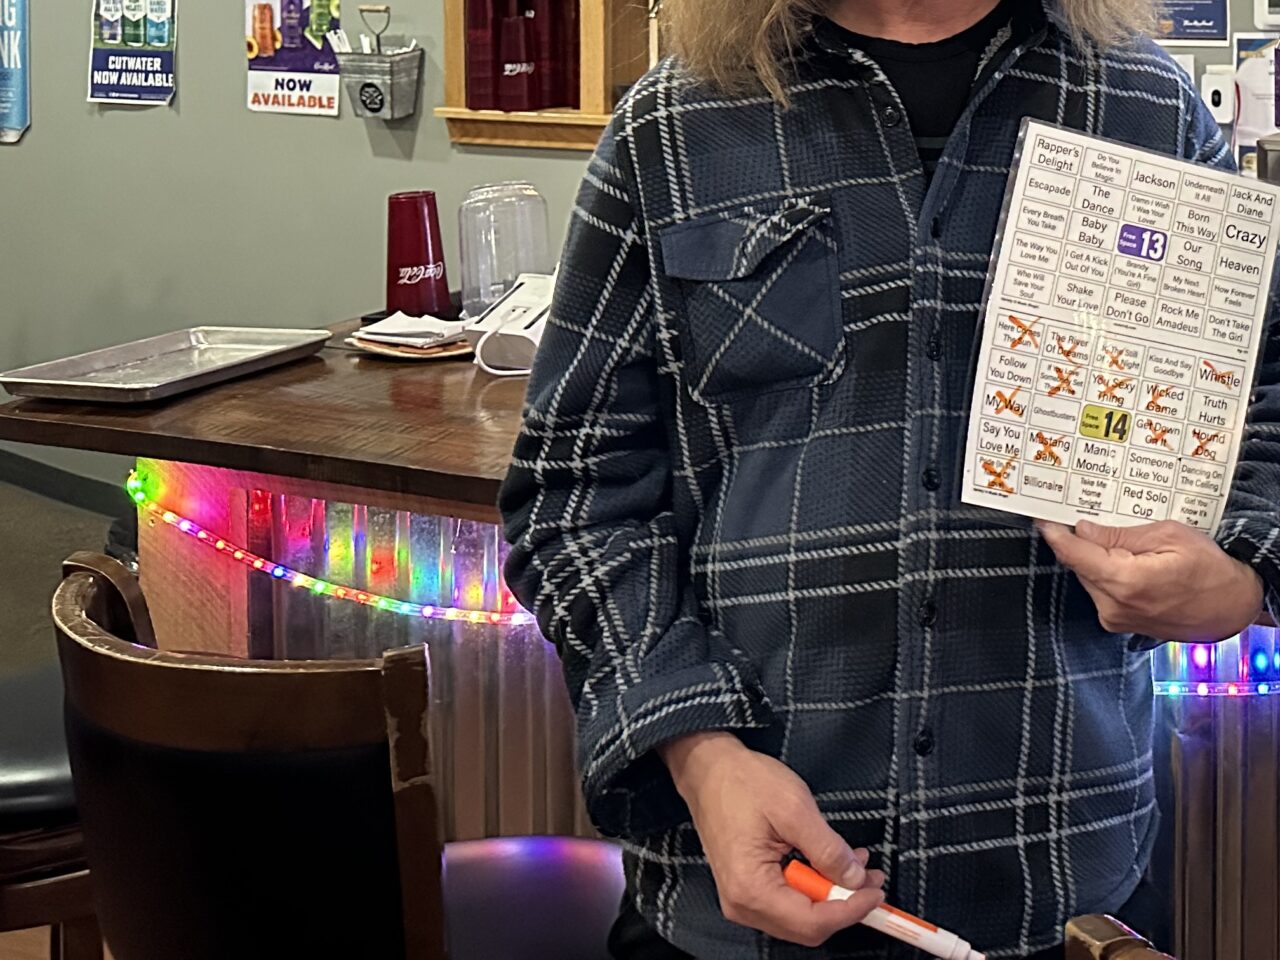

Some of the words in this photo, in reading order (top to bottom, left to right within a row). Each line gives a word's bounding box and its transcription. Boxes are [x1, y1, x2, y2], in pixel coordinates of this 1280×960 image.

[108, 56, 161, 70] CUTWATER
[94, 71, 119, 84] NOW
[120, 72, 173, 87] AVAILABLE
[274, 78, 312, 91] NOW
[251, 94, 335, 109] AVAILABLE
[1037, 138, 1080, 158] Rapper's
[1038, 154, 1073, 171] Delight
[1028, 178, 1071, 196] Escapade
[1135, 171, 1176, 189] Jackson
[1092, 185, 1111, 198] The
[1232, 188, 1252, 201] Jack
[1255, 195, 1273, 206] And
[1082, 199, 1114, 215] Dance
[1237, 204, 1264, 218] Diane
[1081, 216, 1108, 233] Baby
[1188, 209, 1210, 223] Born
[1078, 231, 1104, 248] Baby
[1176, 221, 1196, 234] This
[1197, 226, 1217, 241] Way
[1225, 224, 1267, 249] Crazy
[1184, 241, 1203, 253] Our
[1177, 255, 1203, 271] Song
[1219, 256, 1260, 275] Heaven
[1066, 282, 1094, 297] Shake
[1114, 292, 1147, 308] Please
[1106, 306, 1133, 321] Don't
[1134, 313, 1149, 324] Go
[1160, 303, 1184, 315] Rock
[1185, 309, 1200, 320] Me
[1156, 317, 1199, 334] Amadeus
[999, 355, 1027, 368] Follow
[990, 367, 1005, 379] You
[1007, 372, 1032, 384] Down
[1146, 401, 1178, 415] Game
[1203, 396, 1228, 410] Truth
[1104, 411, 1127, 440] 14
[1199, 411, 1226, 426] Hurts
[982, 422, 1002, 437] Say
[1004, 427, 1020, 439] You
[980, 438, 1002, 452] Love
[1005, 443, 1020, 455] Me
[1076, 459, 1118, 477] Monday
[1130, 452, 1174, 469] Someone
[1024, 475, 1063, 492] Billionaire
[1130, 468, 1150, 480] Like
[1152, 472, 1169, 484] You
[1123, 487, 1143, 499] Red
[1145, 491, 1168, 504] Solo
[1132, 504, 1153, 517] Cup
